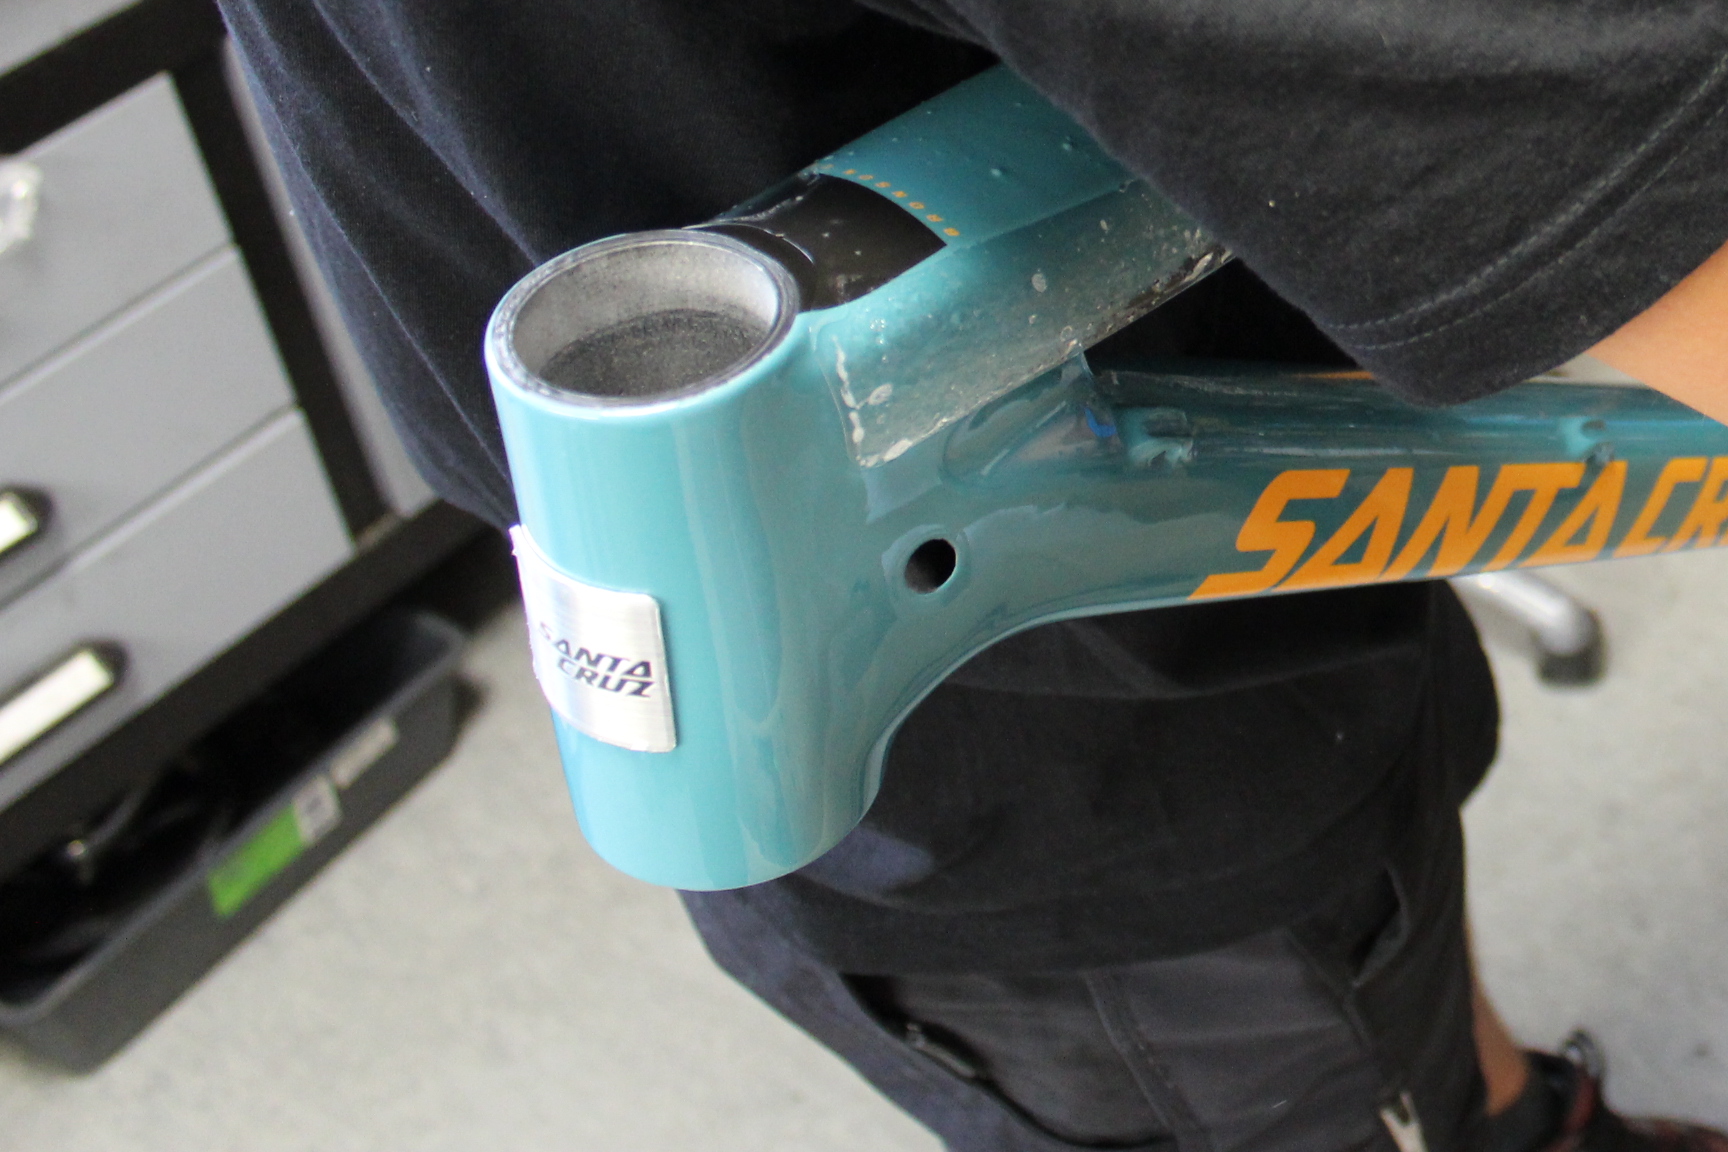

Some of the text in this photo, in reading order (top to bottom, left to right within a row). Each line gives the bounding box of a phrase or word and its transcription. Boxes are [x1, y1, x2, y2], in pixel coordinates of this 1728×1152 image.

[1187, 459, 1629, 600] SANTA
[539, 620, 653, 678] SANTA
[557, 656, 655, 698] CRUZ
